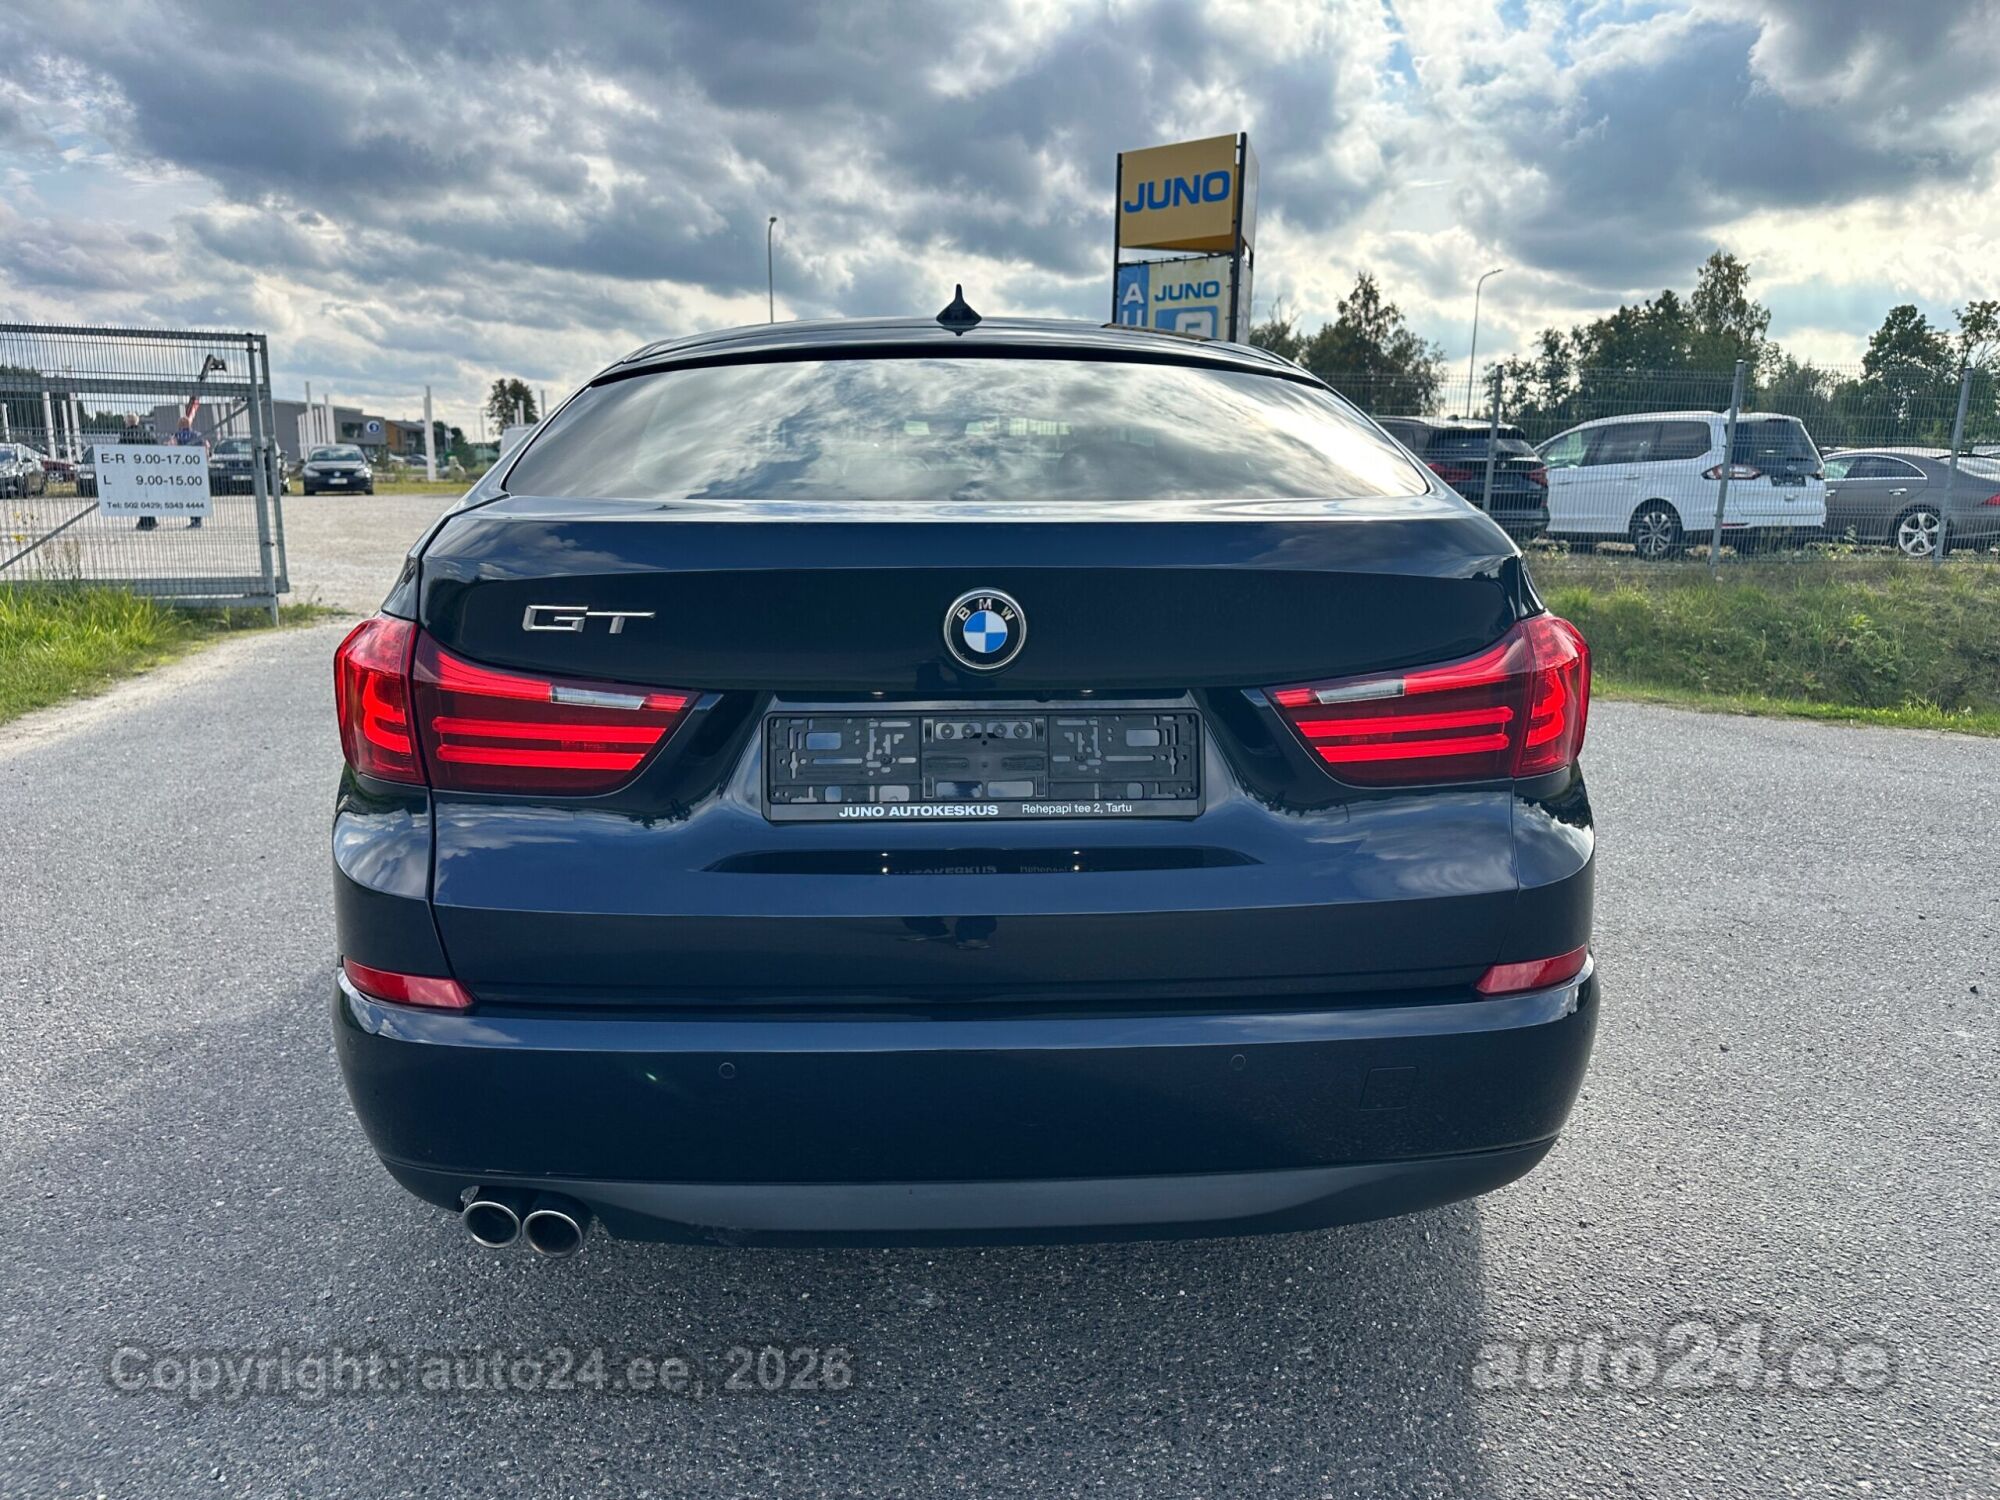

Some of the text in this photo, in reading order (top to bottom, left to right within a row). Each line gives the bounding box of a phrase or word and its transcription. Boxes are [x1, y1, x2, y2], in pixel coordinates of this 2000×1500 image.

[1123, 170, 1231, 214] JUNO
[1154, 280, 1220, 302] JUNO
[101, 453, 201, 465] E-R 9.00-17.00
[103, 475, 203, 486] L 9.00-15.00
[522, 605, 656, 634] GT
[956, 598, 1016, 621] BMW
[839, 802, 1133, 818] JUNO AUTOKESKUS Rehepapi tee 2, Tartu
